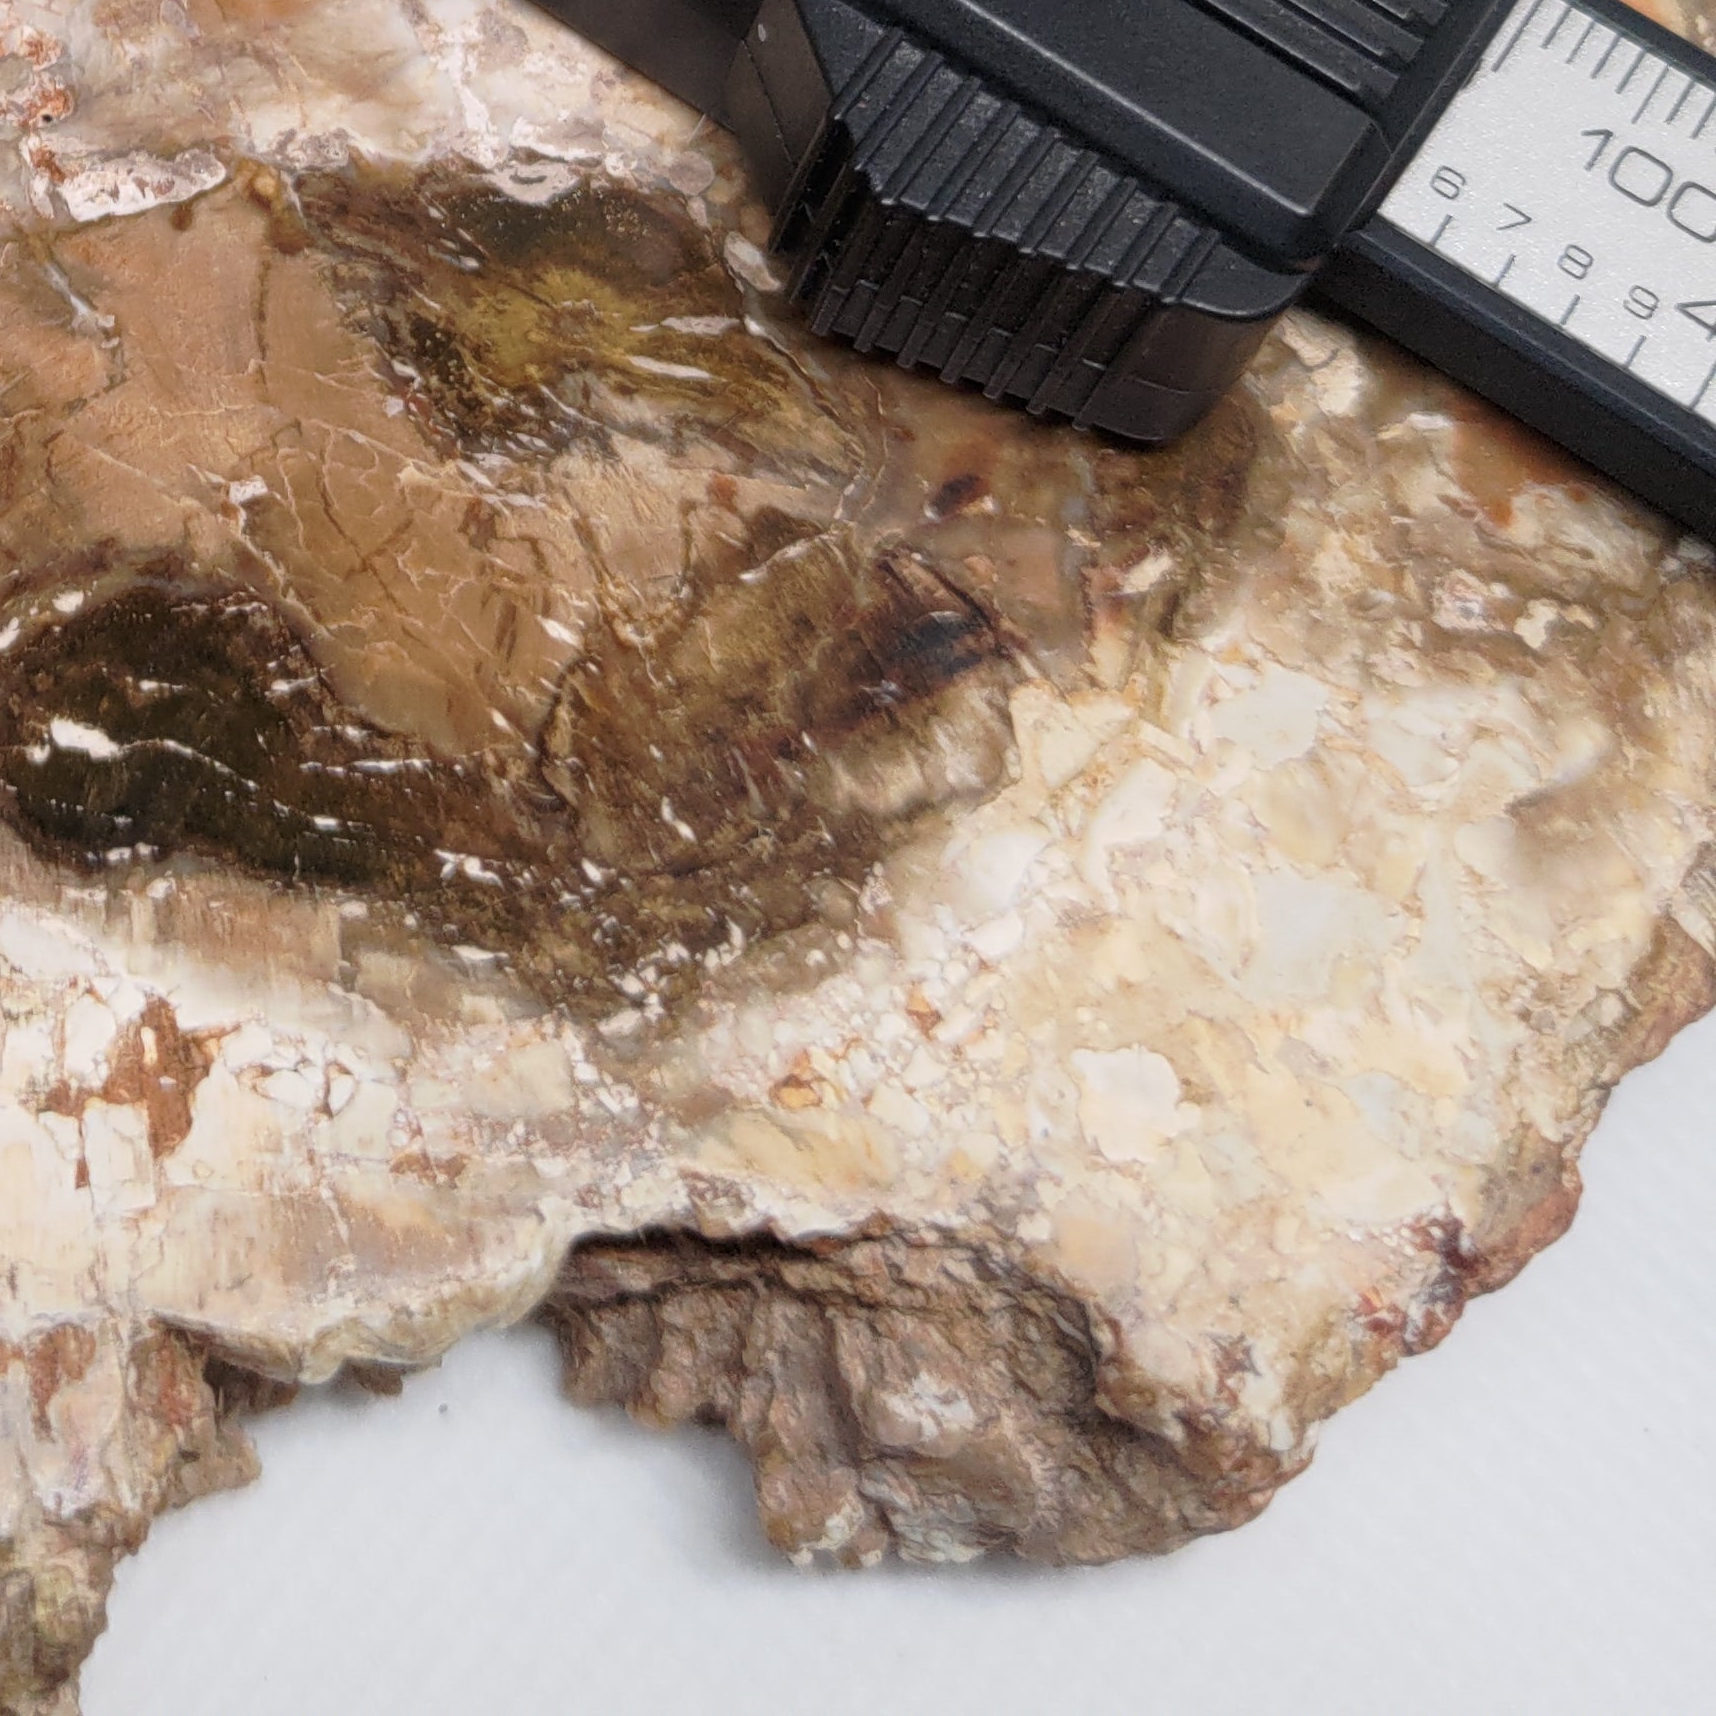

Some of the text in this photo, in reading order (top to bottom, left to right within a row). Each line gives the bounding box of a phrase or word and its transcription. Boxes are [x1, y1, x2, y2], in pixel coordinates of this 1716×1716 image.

[1429, 165, 1466, 200] 6
[1495, 202, 1532, 231] 7
[1557, 244, 1594, 280] 8
[1623, 285, 1660, 320] 9
[1581, 127, 1716, 244] 100
